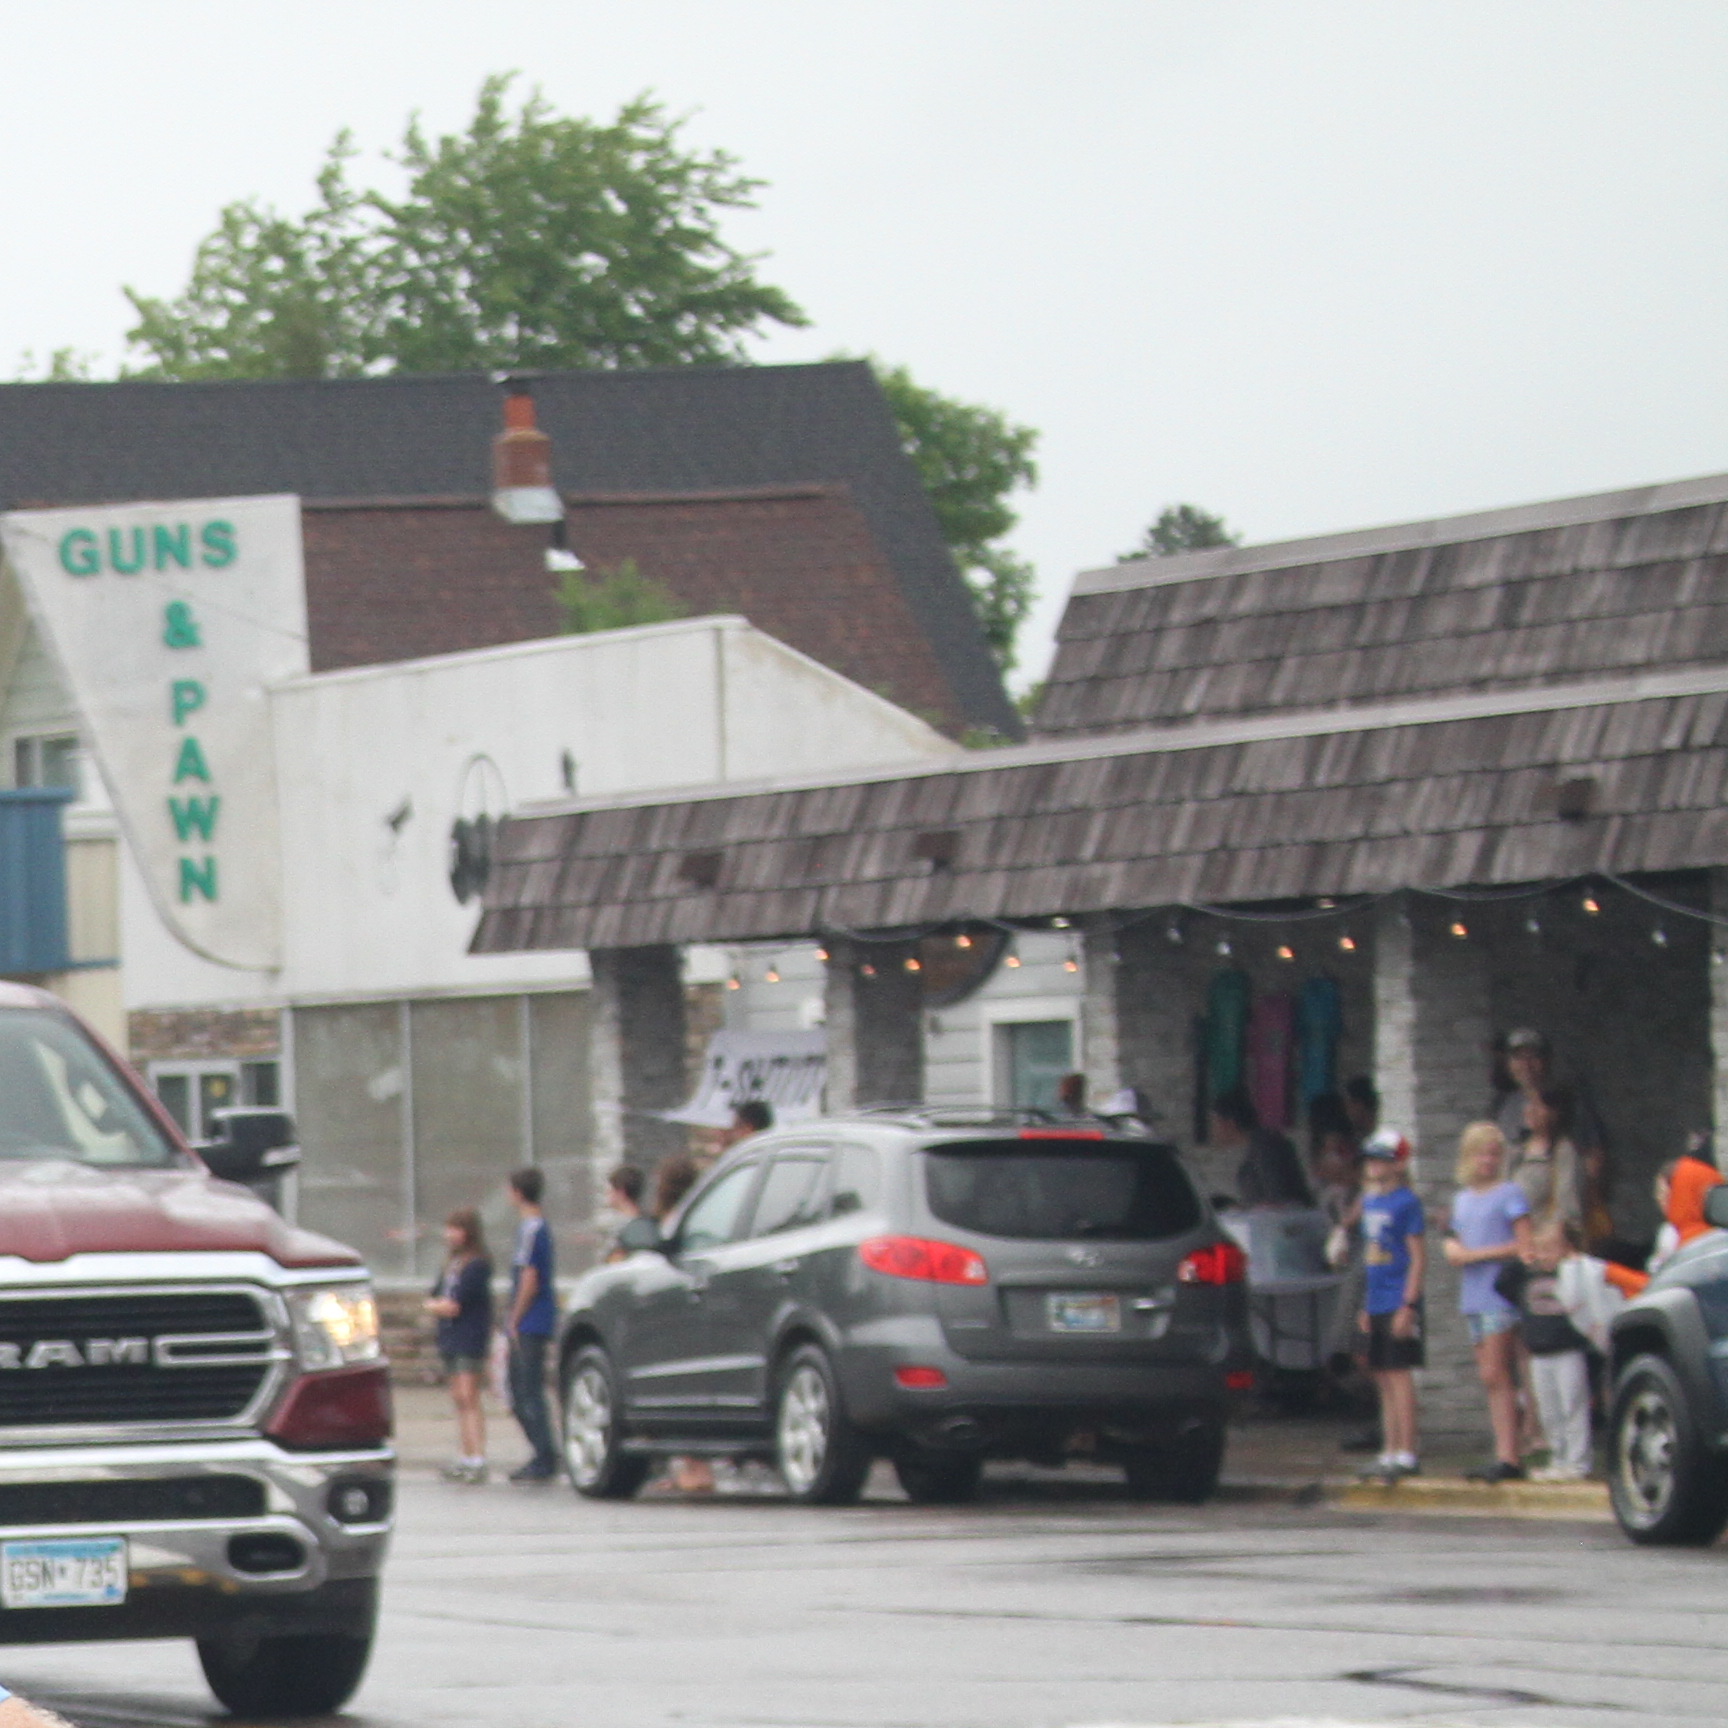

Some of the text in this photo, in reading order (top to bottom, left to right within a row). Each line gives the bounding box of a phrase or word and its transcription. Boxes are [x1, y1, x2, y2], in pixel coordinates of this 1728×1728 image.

[58, 520, 238, 576] GUNS
[162, 600, 221, 904] & PAWN
